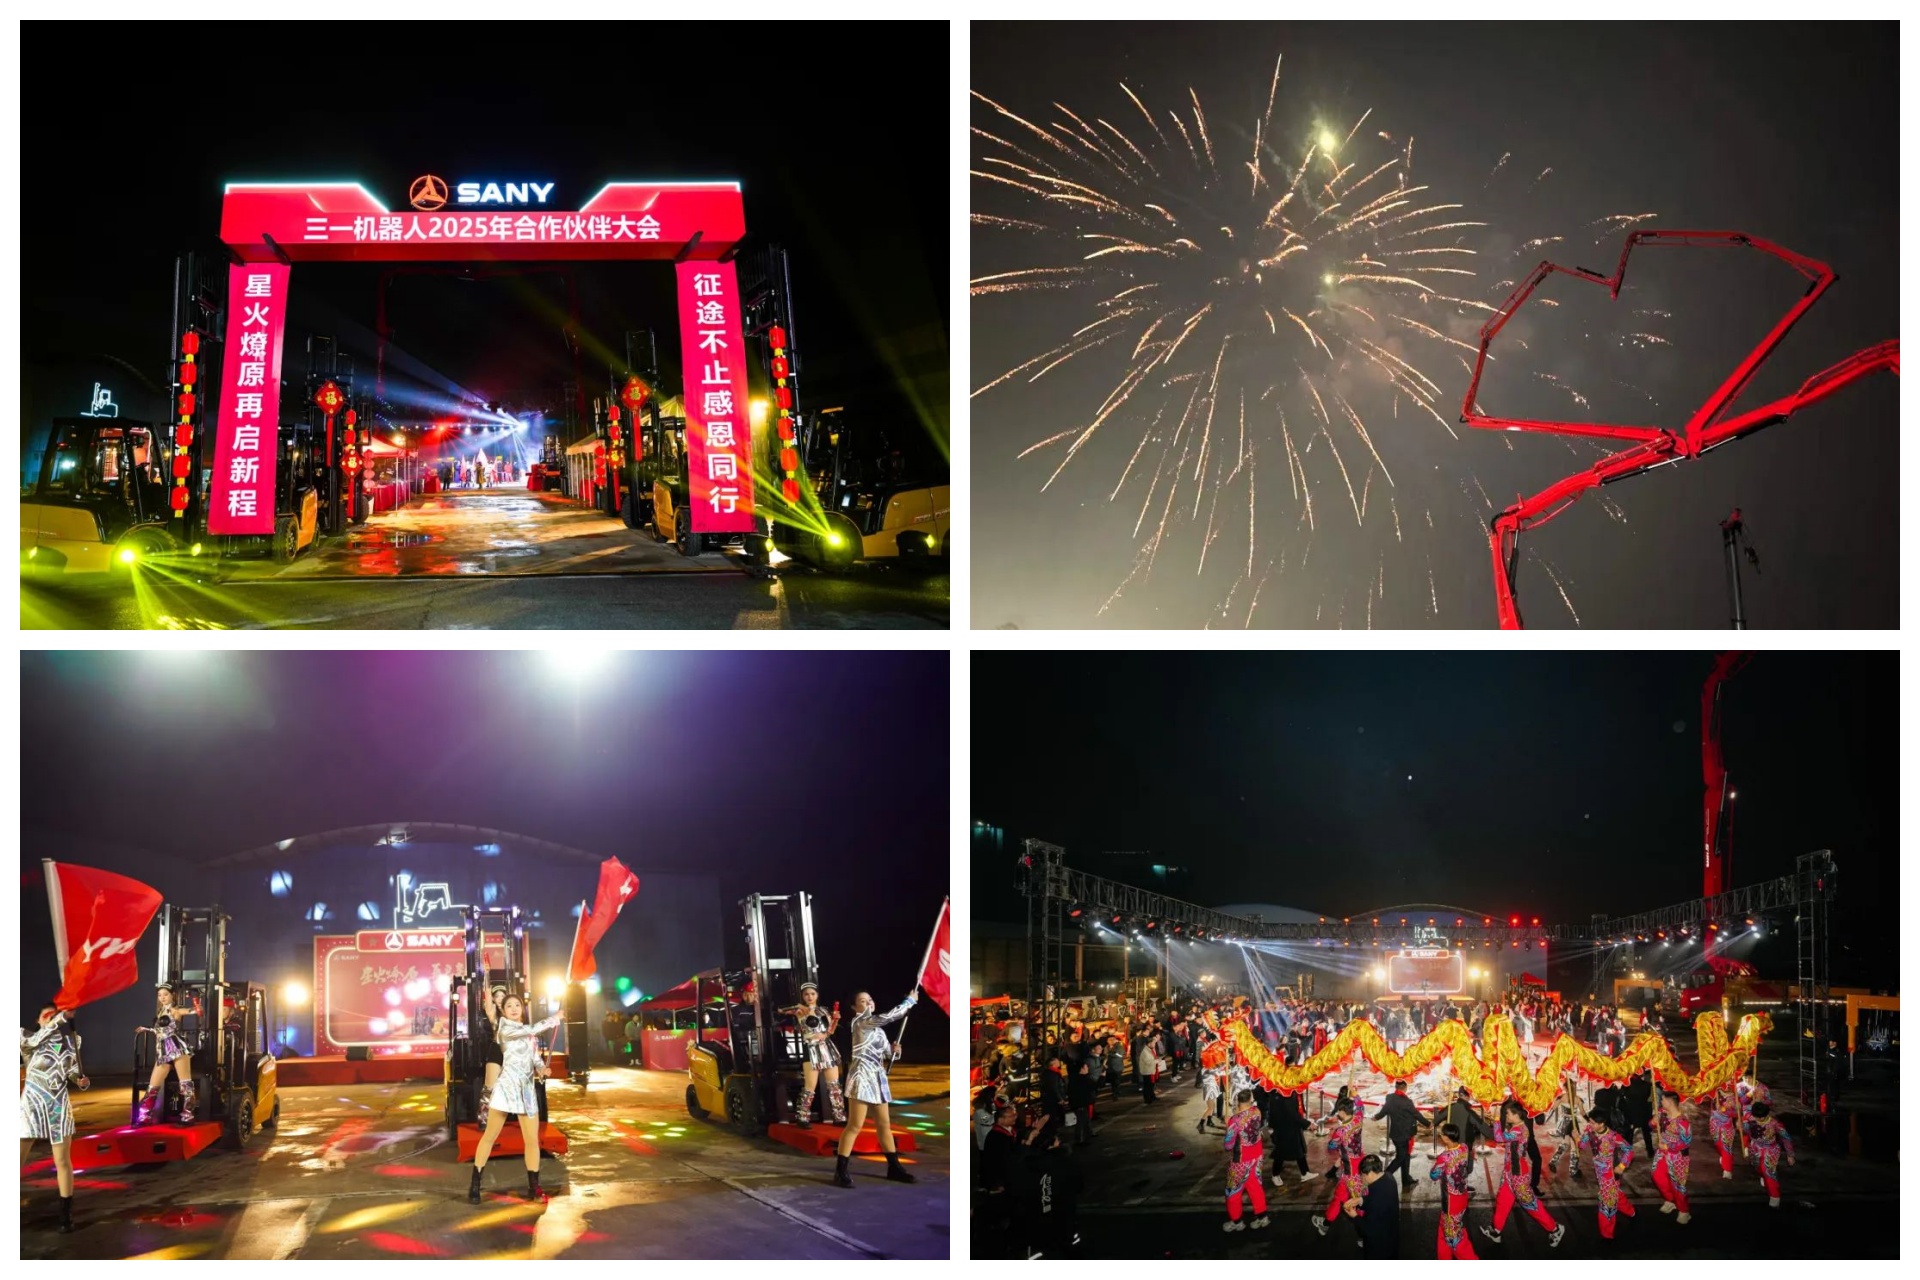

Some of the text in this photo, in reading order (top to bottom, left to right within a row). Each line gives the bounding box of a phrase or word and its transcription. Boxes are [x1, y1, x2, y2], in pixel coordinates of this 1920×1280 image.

[457, 183, 555, 203] SANY
[304, 215, 661, 241] 三一机器人2025年合作伙伴大会
[227, 273, 272, 518] 星火燎原再启新程
[693, 272, 740, 514] 征途不止感恩同行
[406, 934, 454, 947] SANY
